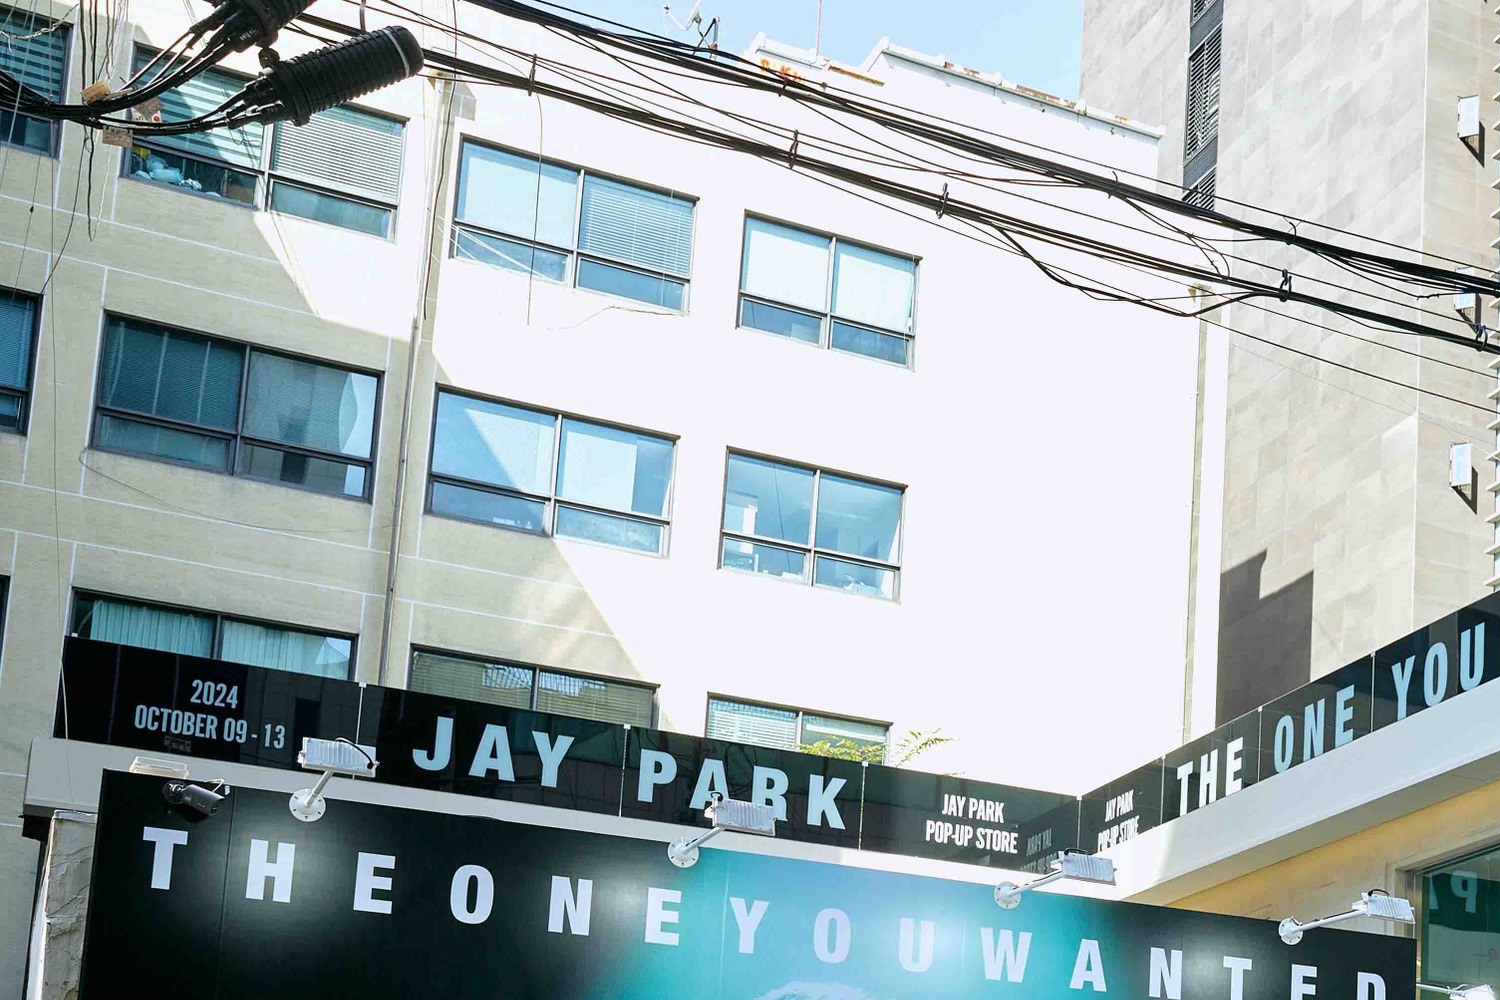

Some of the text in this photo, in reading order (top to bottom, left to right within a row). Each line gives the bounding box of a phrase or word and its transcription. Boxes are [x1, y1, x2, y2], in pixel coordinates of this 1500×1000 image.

[190, 679, 239, 709] 2024
[134, 704, 218, 740] OCTOBER
[1175, 738, 1245, 816] THE
[1273, 683, 1356, 774] ONE
[1391, 622, 1486, 722] YOU
[412, 715, 847, 831] JAY PARK
[942, 793, 1005, 824] JAY PARK
[1116, 789, 1135, 816] PARK
[925, 819, 1019, 854] POP-UP STORE
